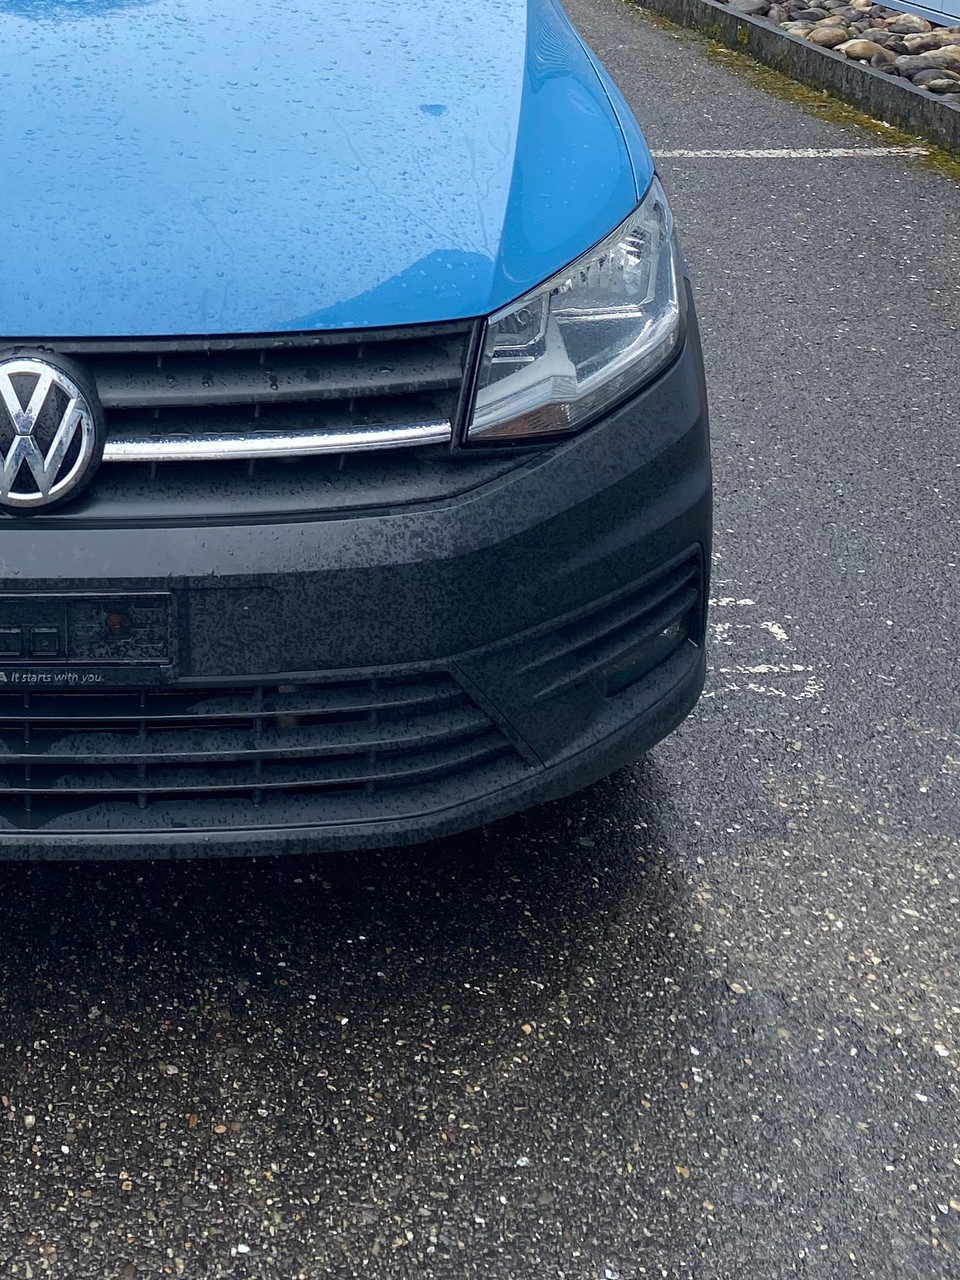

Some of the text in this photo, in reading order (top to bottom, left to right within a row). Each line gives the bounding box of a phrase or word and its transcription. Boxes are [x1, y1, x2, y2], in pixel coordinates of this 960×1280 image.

[11, 672, 20, 682] It
[21, 672, 52, 682] starts
[54, 671, 79, 683] with
[81, 673, 105, 684] you.
